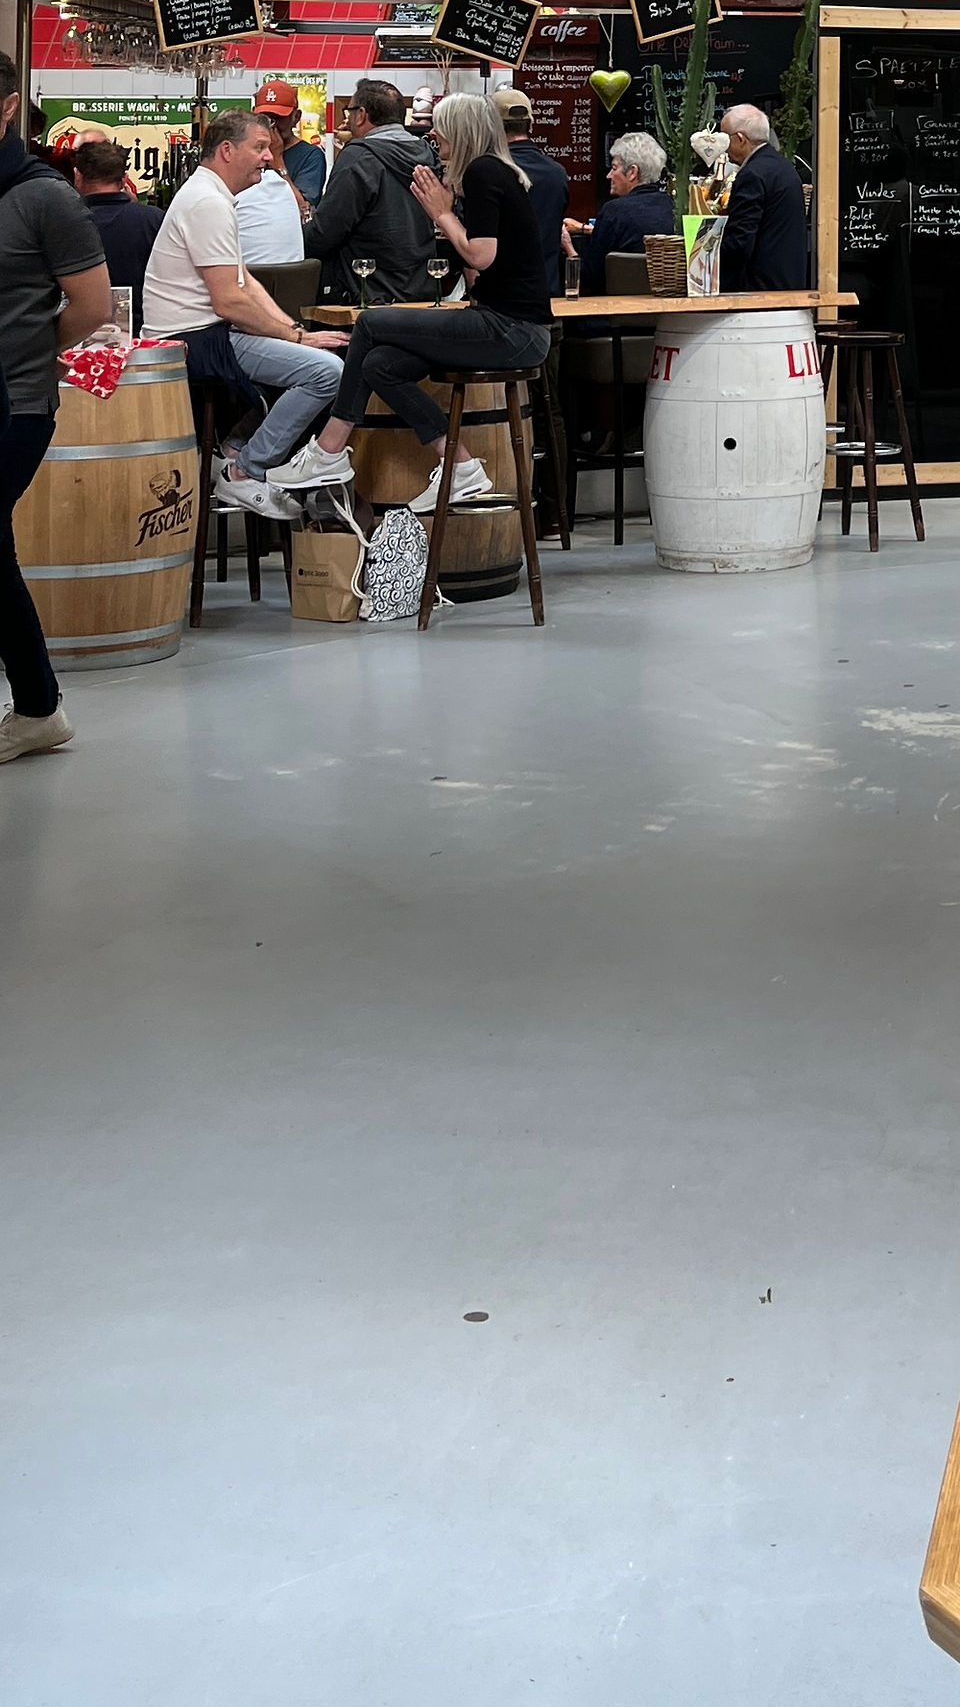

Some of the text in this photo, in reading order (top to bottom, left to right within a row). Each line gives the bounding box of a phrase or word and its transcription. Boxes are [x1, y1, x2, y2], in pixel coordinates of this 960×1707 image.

[540, 20, 588, 42] coffee
[72, 102, 124, 112] BRSSERIE
[127, 102, 170, 112] WAGNR
[135, 489, 193, 547] Fischer
